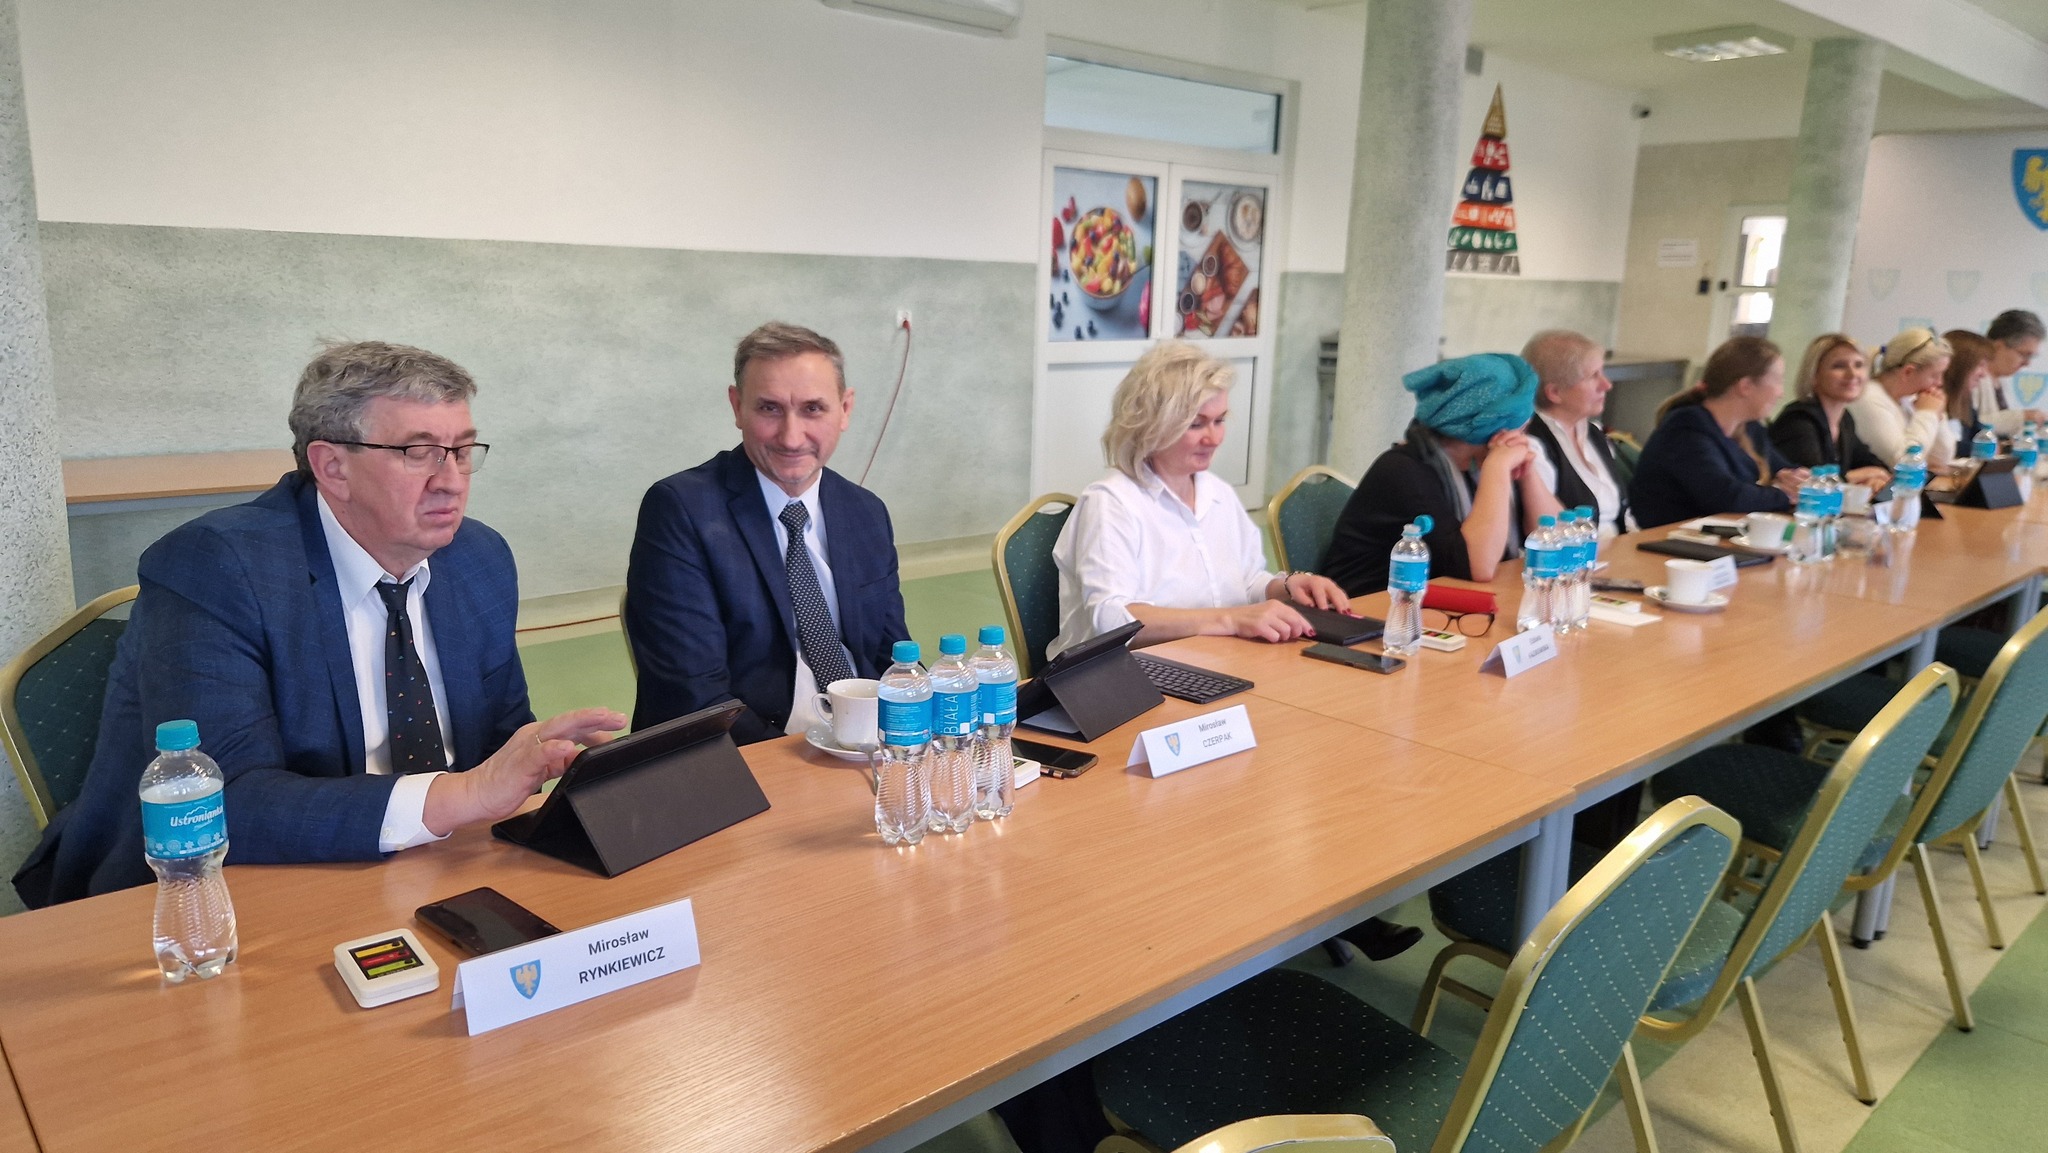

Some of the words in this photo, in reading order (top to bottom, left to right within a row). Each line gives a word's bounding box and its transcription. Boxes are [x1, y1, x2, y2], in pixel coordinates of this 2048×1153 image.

[943, 694, 959, 734] BIAŁA
[1198, 719, 1227, 732] Mirosław
[1202, 732, 1232, 748] CZERPAK
[170, 805, 224, 827] Ustroniank
[588, 929, 649, 955] Mirosław
[579, 947, 665, 984] RYNKIEWICZ
